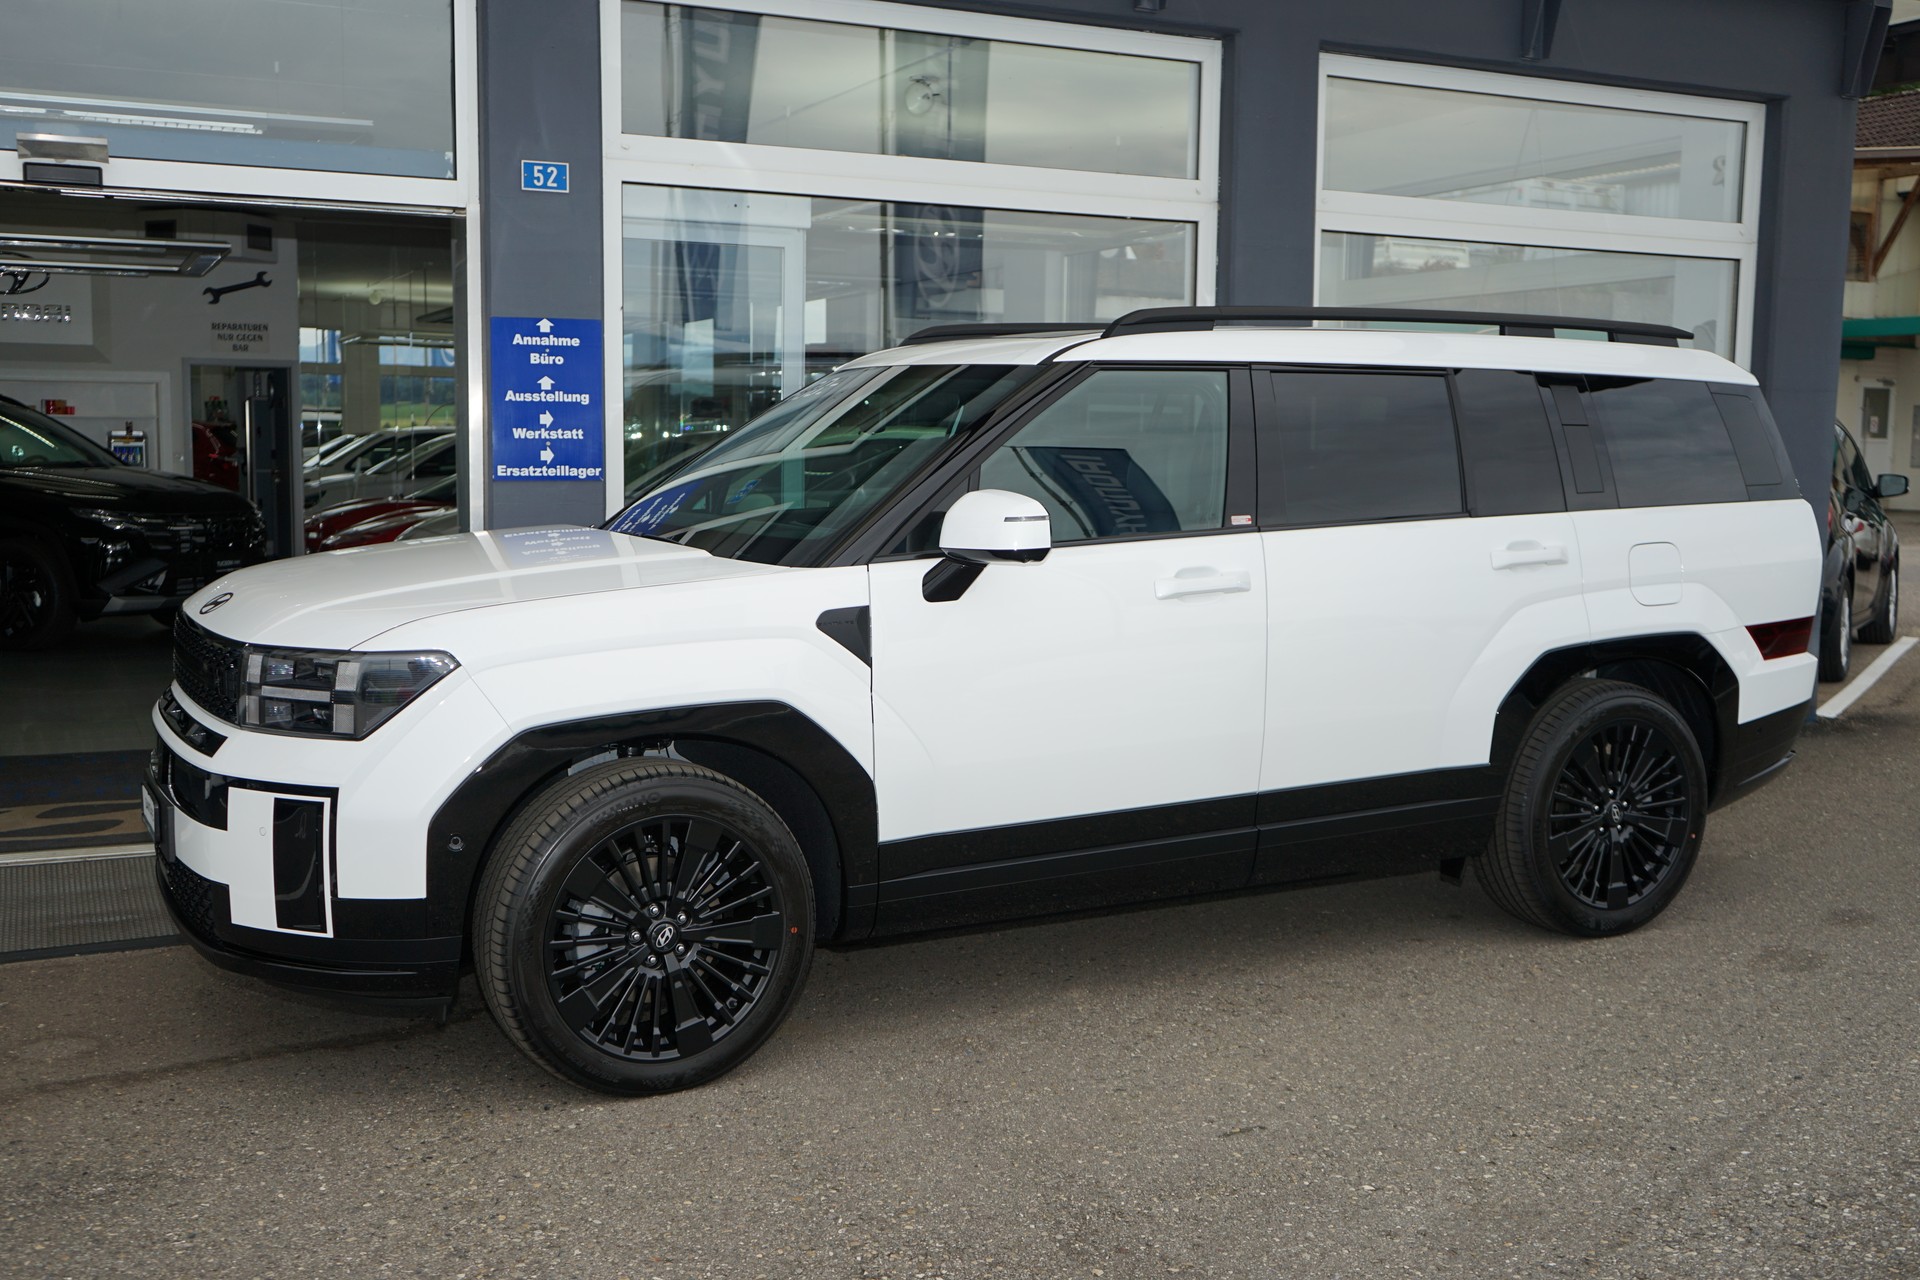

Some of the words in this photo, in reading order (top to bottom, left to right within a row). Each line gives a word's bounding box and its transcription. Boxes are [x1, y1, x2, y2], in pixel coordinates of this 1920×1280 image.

[533, 165, 558, 187] 52
[211, 322, 269, 332] REPARATUREN
[217, 333, 234, 341] NUR
[236, 333, 264, 342] GEGEN
[512, 333, 581, 347] Annahme
[232, 343, 249, 352] BAR
[530, 352, 565, 365] Büro
[505, 390, 590, 405] Ausstellung
[512, 428, 584, 440] Werkstatt
[496, 465, 602, 479] Ersatzteillager
[1060, 454, 1148, 535] HYUNDAI
